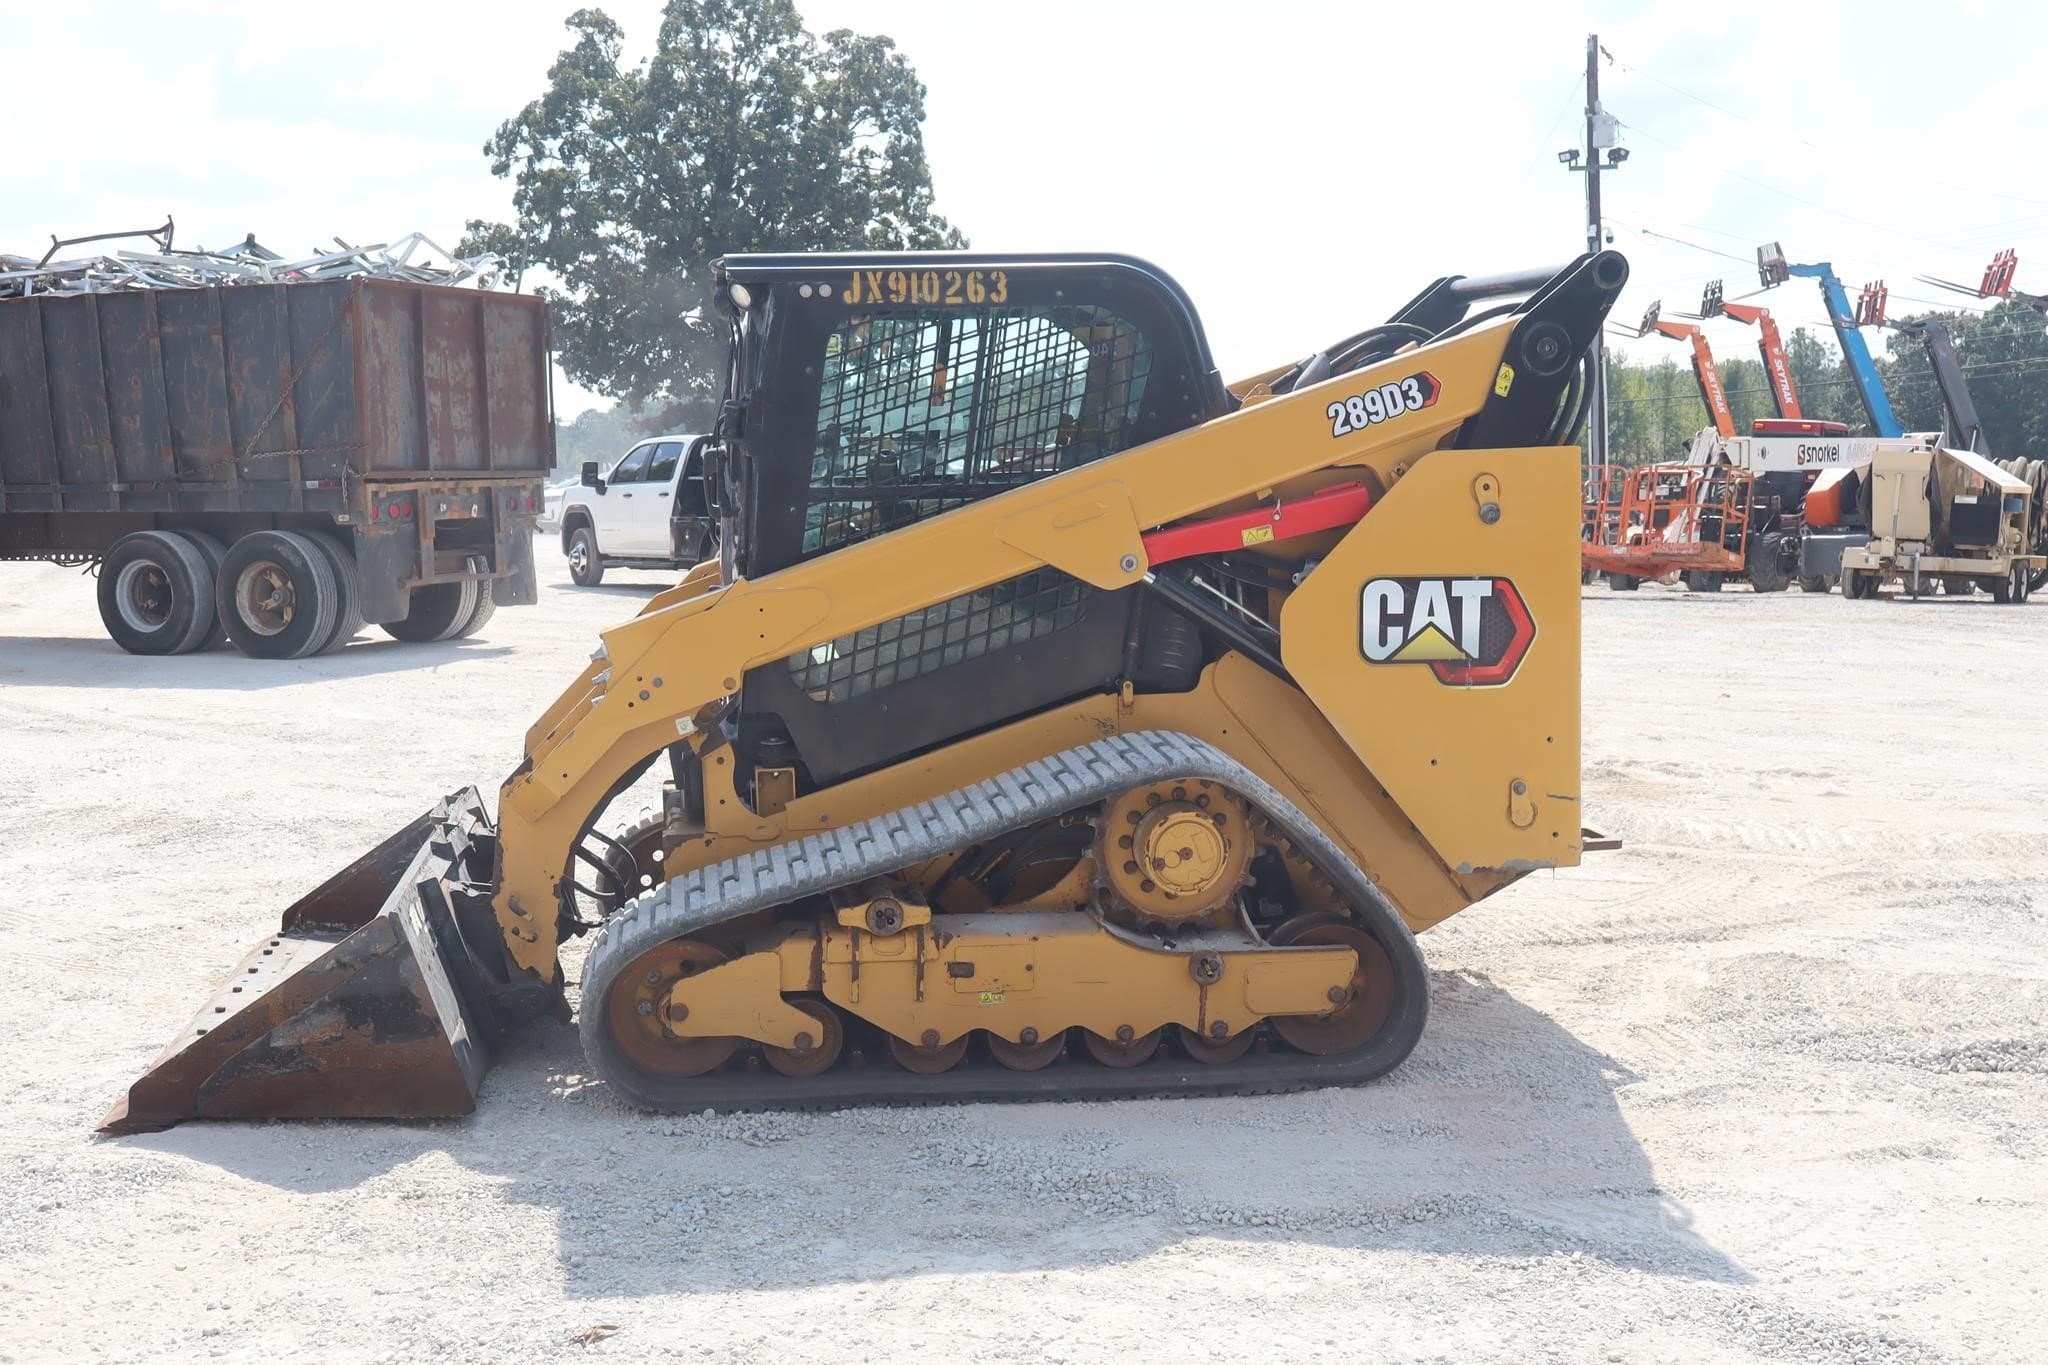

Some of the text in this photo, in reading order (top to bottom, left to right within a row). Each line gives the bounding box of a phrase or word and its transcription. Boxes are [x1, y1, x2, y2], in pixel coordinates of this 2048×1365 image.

[843, 271, 1008, 304] JX910263
[1706, 371, 1727, 413] SKYTRAK
[1773, 359, 1794, 404] SKYTRAK
[1327, 377, 1424, 438] 289D3
[1806, 443, 1840, 463] snorkel
[1362, 579, 1493, 661] CAT
